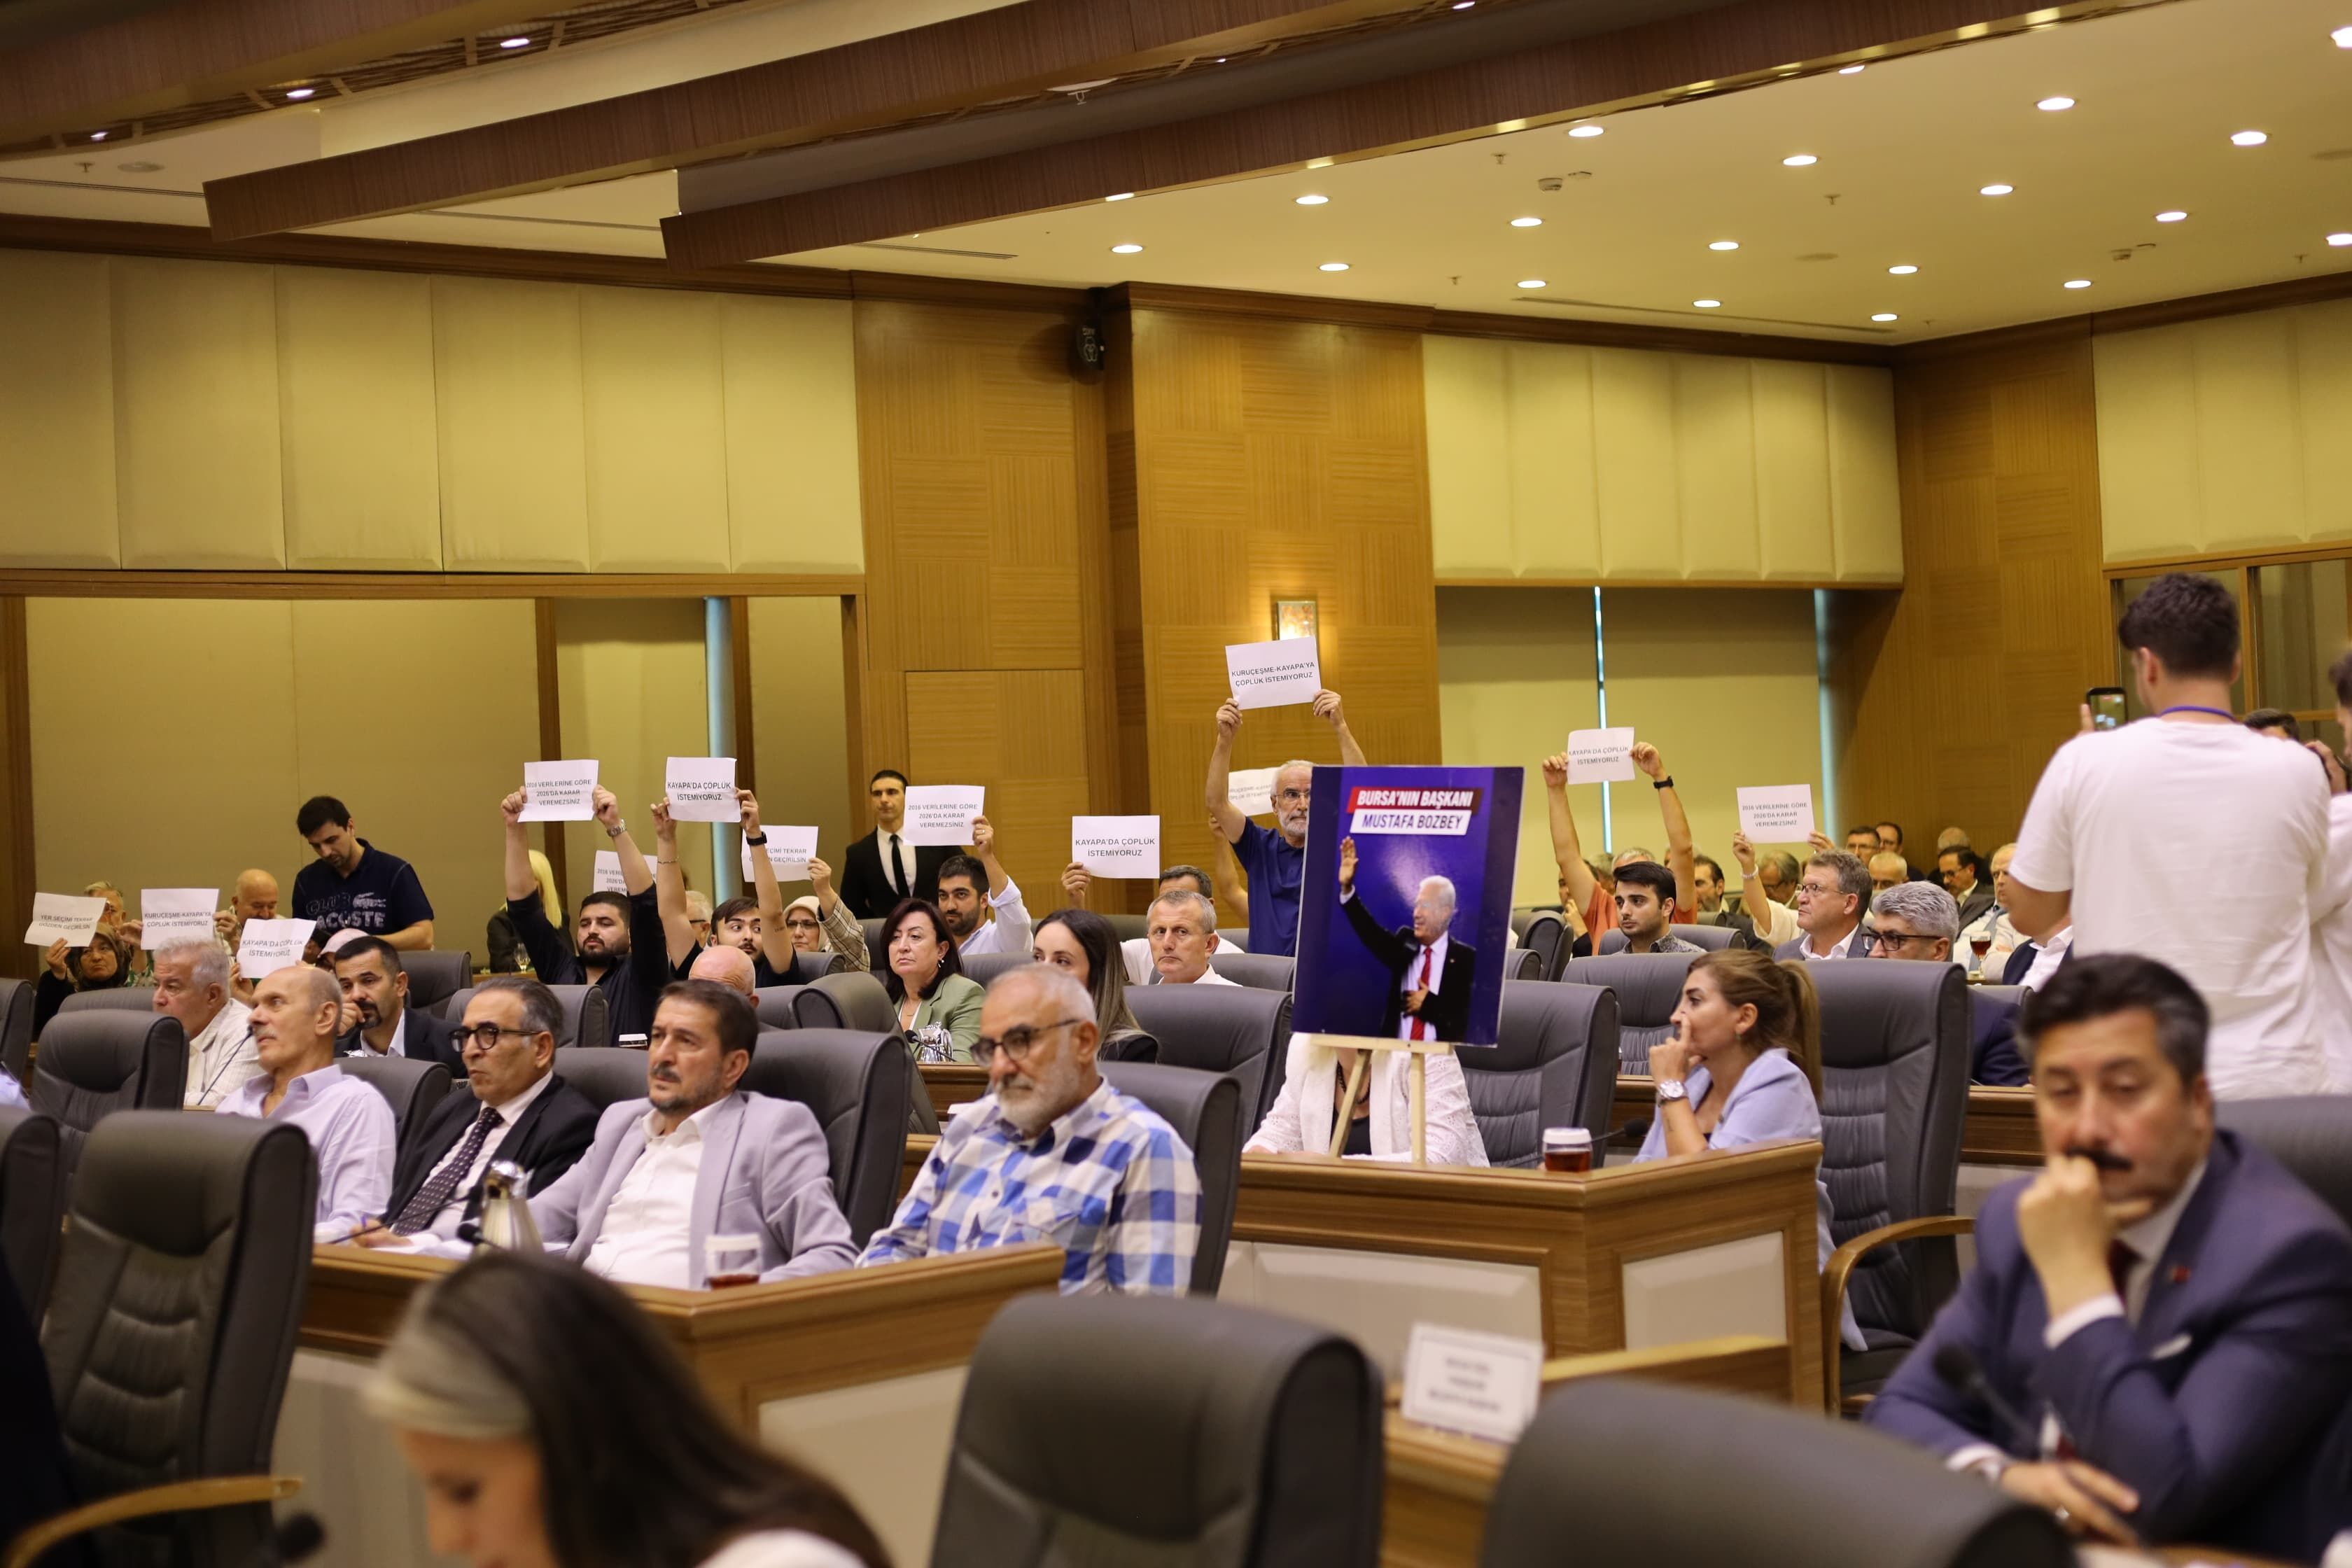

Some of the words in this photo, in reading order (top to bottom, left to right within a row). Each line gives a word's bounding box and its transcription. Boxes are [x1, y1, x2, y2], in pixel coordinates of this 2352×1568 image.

[1265, 671, 1313, 683] İSTEMİYORUZ
[1357, 790, 1421, 806] BURSA'NIN
[1420, 791, 1474, 809] BAŞKANI
[1362, 814, 1414, 828] MUSTAFA
[1417, 816, 1464, 829] BOZBEY
[316, 911, 386, 930] ACOSTE
